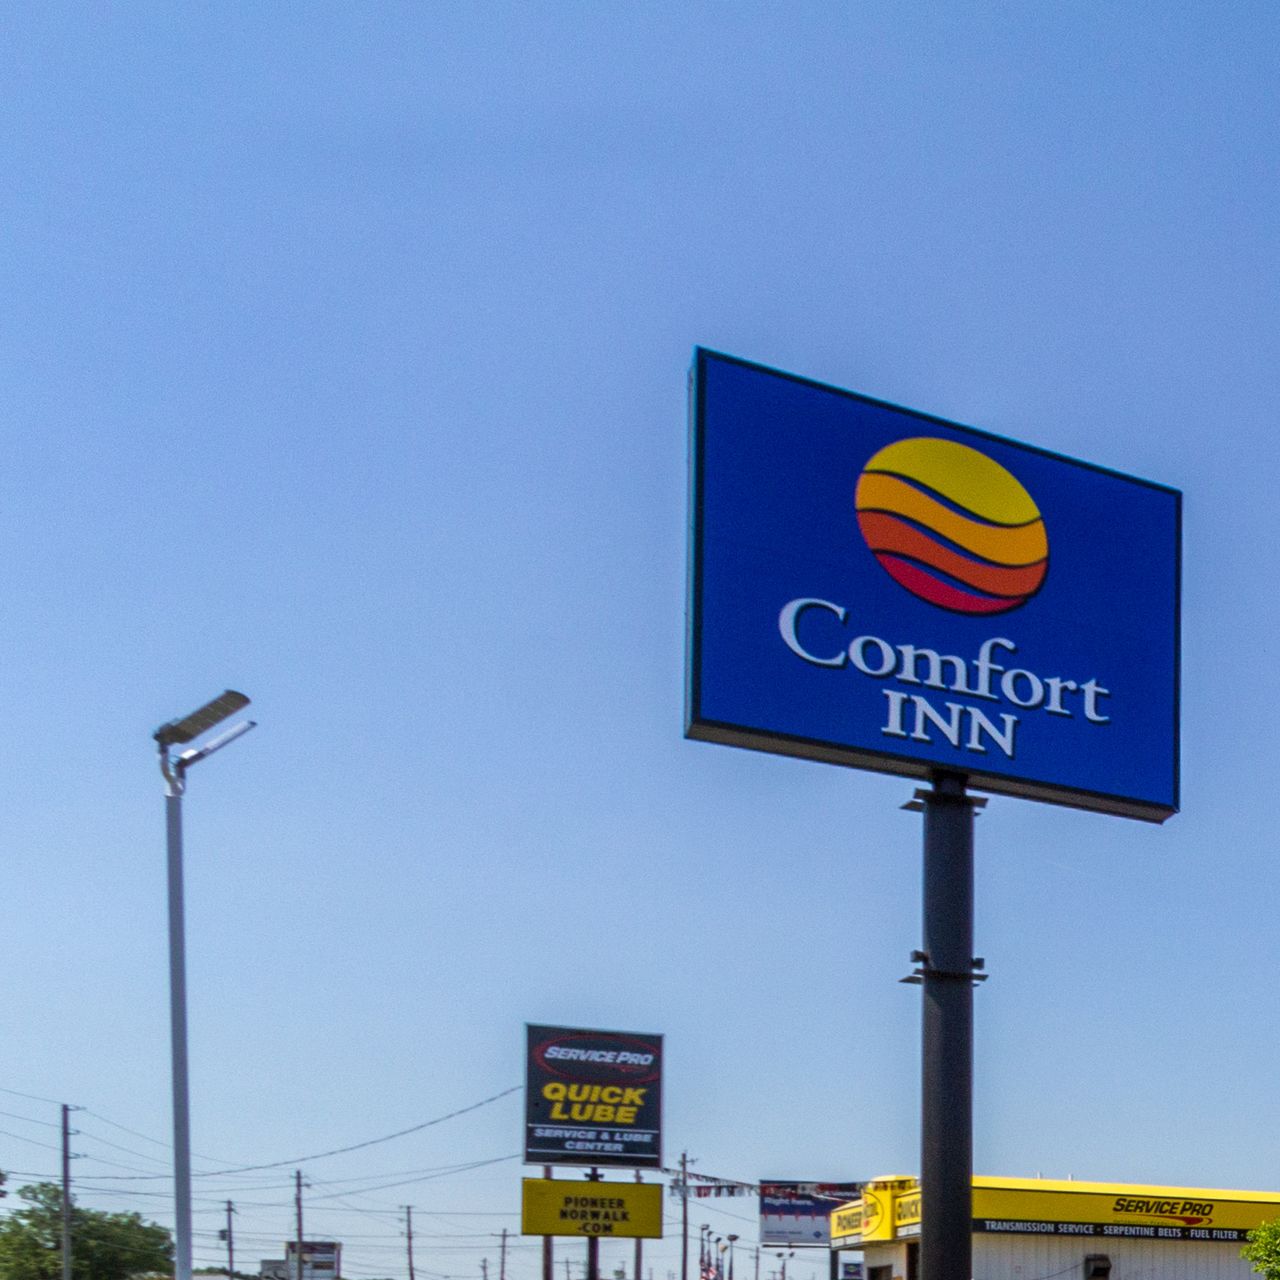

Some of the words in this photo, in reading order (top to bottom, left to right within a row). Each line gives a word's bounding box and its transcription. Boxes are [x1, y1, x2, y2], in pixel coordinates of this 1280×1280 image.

[778, 597, 1110, 722] Comfort
[881, 688, 1018, 757] INN
[544, 1046, 617, 1063] SERVICE
[616, 1052, 654, 1066] PRO
[542, 1082, 647, 1106] QUICK
[549, 1102, 639, 1124] LUBE
[534, 1128, 597, 1140] SERVICE
[601, 1132, 609, 1140] &
[614, 1133, 653, 1142] LUBE
[564, 1141, 624, 1152] CENTER
[564, 1197, 625, 1209] PIONEER
[1112, 1198, 1179, 1215] SERVICE
[1178, 1201, 1214, 1217] PRO
[560, 1209, 629, 1221] NORWALK
[985, 1220, 1055, 1233] TRANSMISSION
[1058, 1223, 1094, 1234] SERVICE
[1103, 1225, 1155, 1237] SERPENTINE
[1158, 1227, 1182, 1238] BELTS
[1190, 1229, 1210, 1239] FUEL
[1212, 1230, 1238, 1240] FILTER
